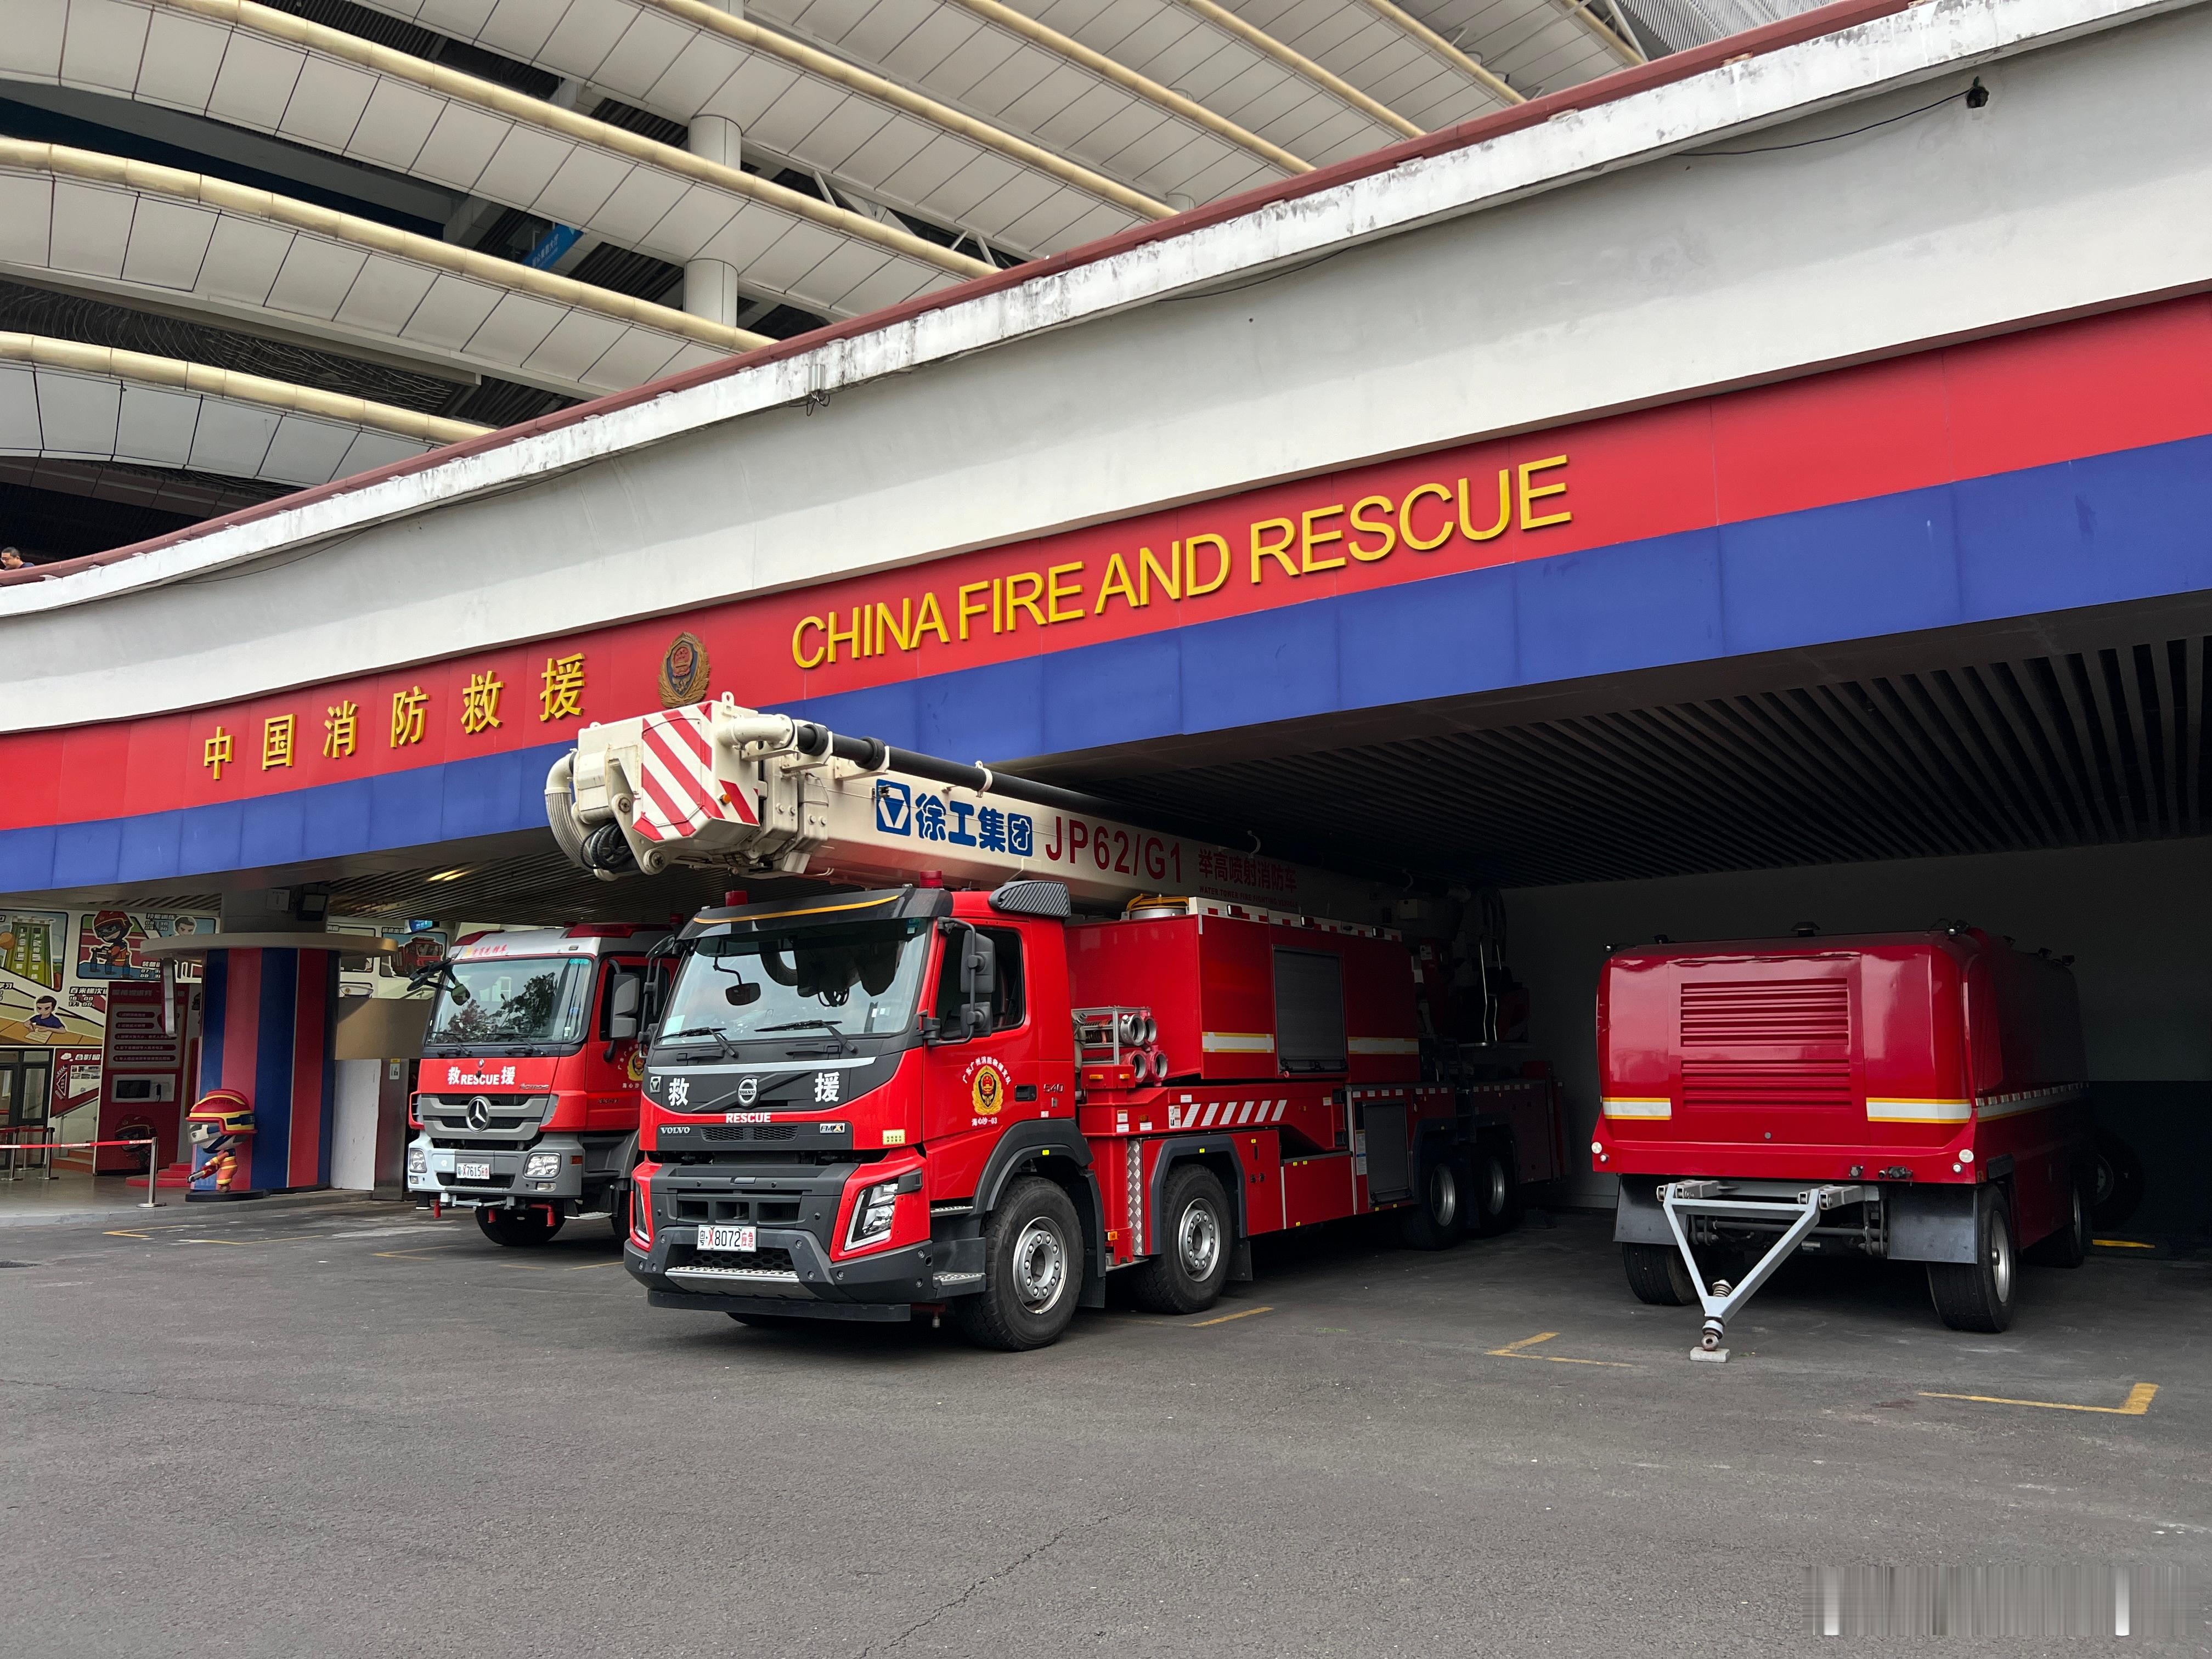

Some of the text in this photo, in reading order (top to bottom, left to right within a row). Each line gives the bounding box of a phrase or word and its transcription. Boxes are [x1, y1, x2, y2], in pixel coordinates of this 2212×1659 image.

[792, 454, 1572, 669] CHINA FIRE AND RESCUE
[204, 653, 586, 780] 中国消防救援
[915, 792, 1033, 857] 徐工集团
[1045, 815, 1182, 884] JP62/G1
[1198, 848, 1297, 894] 举高喷射消防车
[1199, 885, 1218, 896] WATER
[1220, 889, 1239, 899] TOWER
[1240, 892, 1252, 901] FIRE
[448, 1066, 516, 1085] 救 RESCUE 援
[668, 1071, 839, 1106] 救 援
[1043, 1084, 1063, 1092] 540
[726, 1112, 771, 1124] RESCUE
